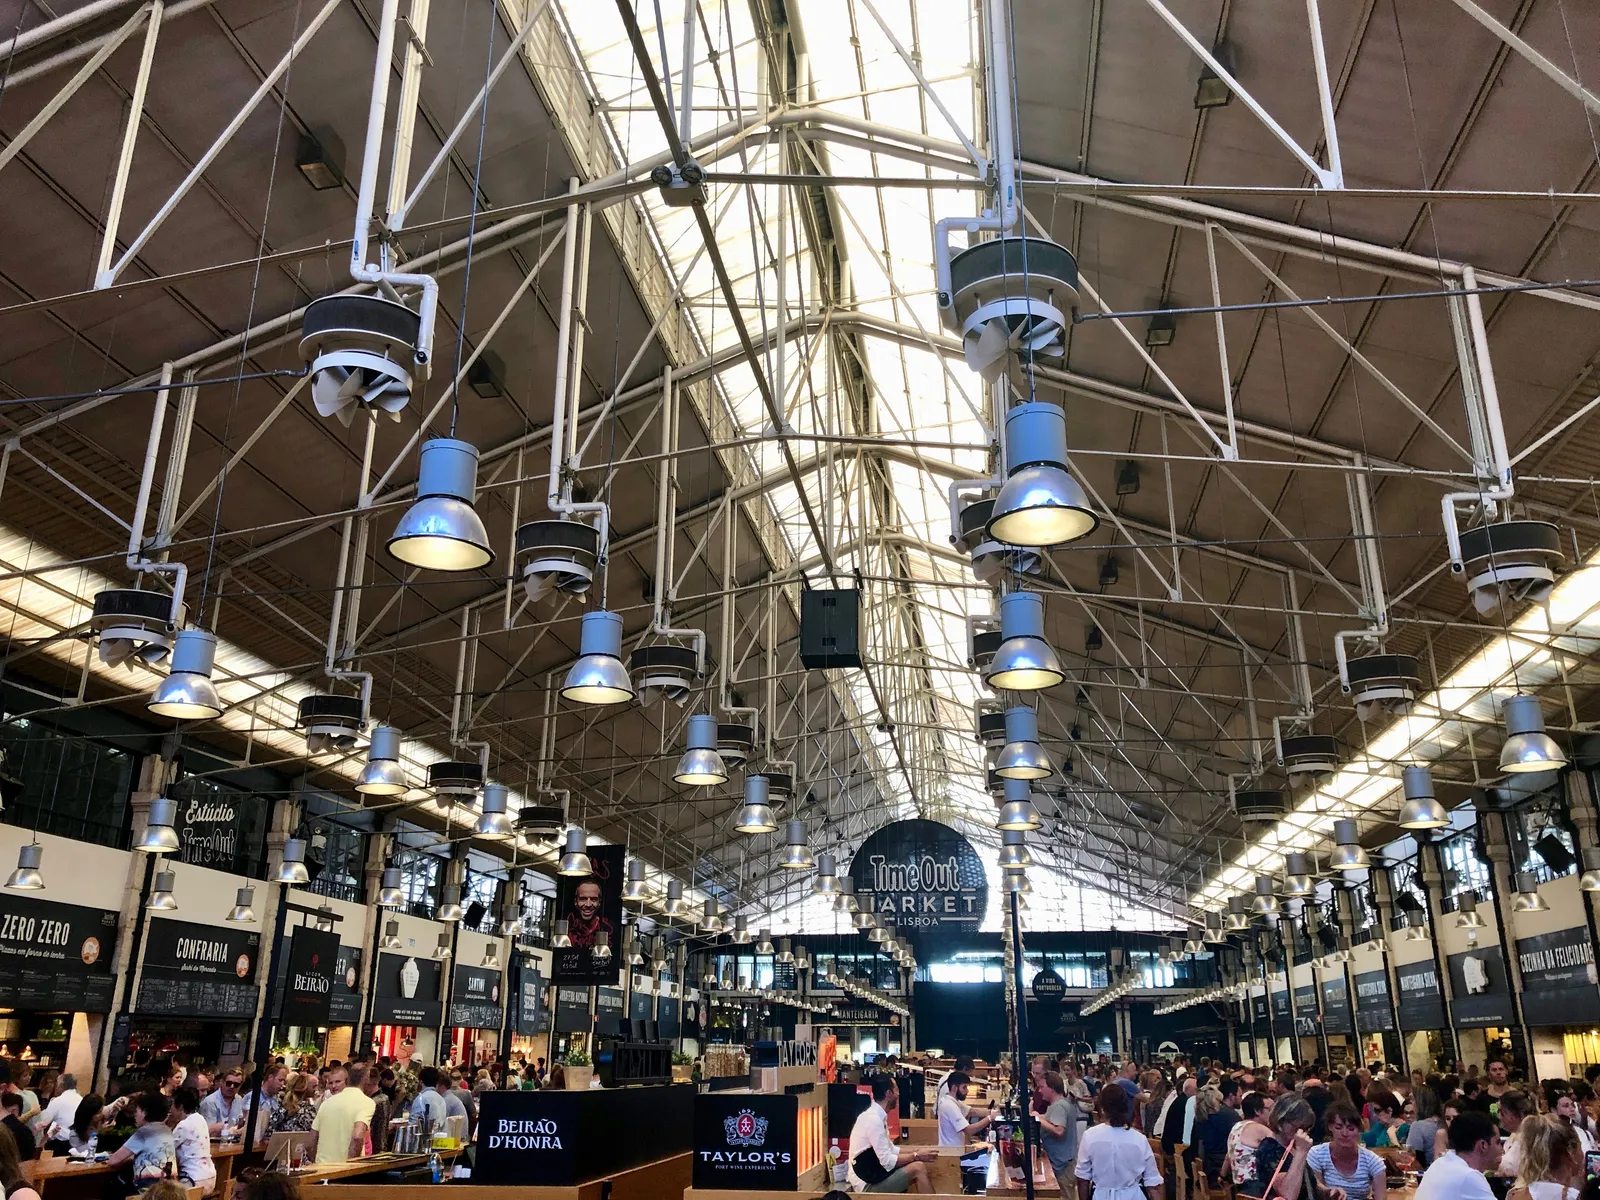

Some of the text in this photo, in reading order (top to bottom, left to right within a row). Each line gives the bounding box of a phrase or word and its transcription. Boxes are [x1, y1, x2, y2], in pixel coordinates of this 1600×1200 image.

[185, 799, 235, 824] Estúdio
[870, 854, 960, 892] Time Out
[1, 914, 35, 942] ZERO
[37, 919, 71, 946] ZERO
[897, 917, 939, 927] LISBOA
[176, 937, 228, 963] CONFRARIA
[1519, 951, 1546, 973] COZINHA
[1545, 949, 1556, 970] DA
[294, 973, 330, 993] BEIRÃO
[777, 1040, 817, 1067] TAYLOR'S
[498, 1118, 557, 1135] BEIRÃO
[488, 1135, 563, 1150] D'HONRA
[700, 1151, 791, 1165] TAYLOR'S
